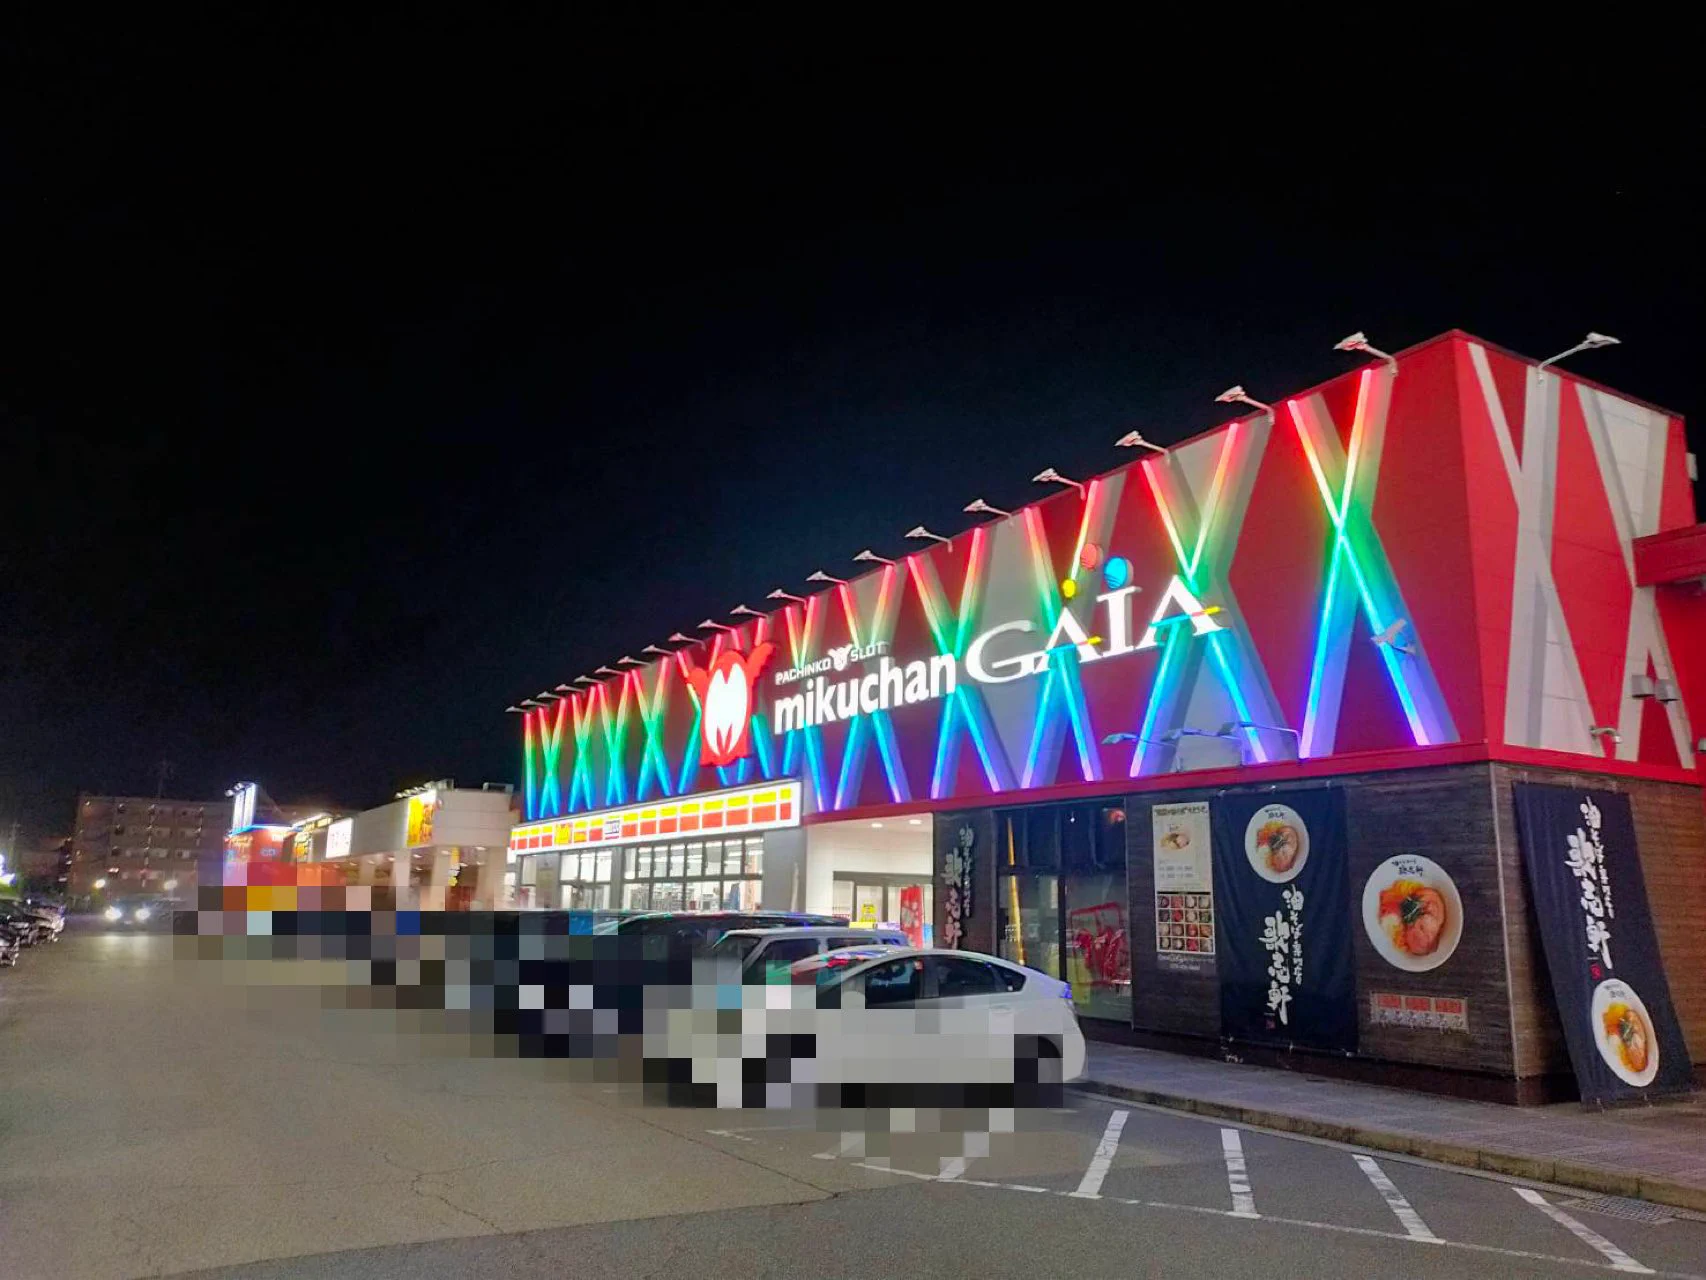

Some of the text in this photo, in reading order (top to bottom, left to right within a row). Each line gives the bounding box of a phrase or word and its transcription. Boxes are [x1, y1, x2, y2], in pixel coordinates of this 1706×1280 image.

[774, 574, 1224, 735] mikuchan GAIA
[775, 641, 889, 686] PACHINKO SLOT
